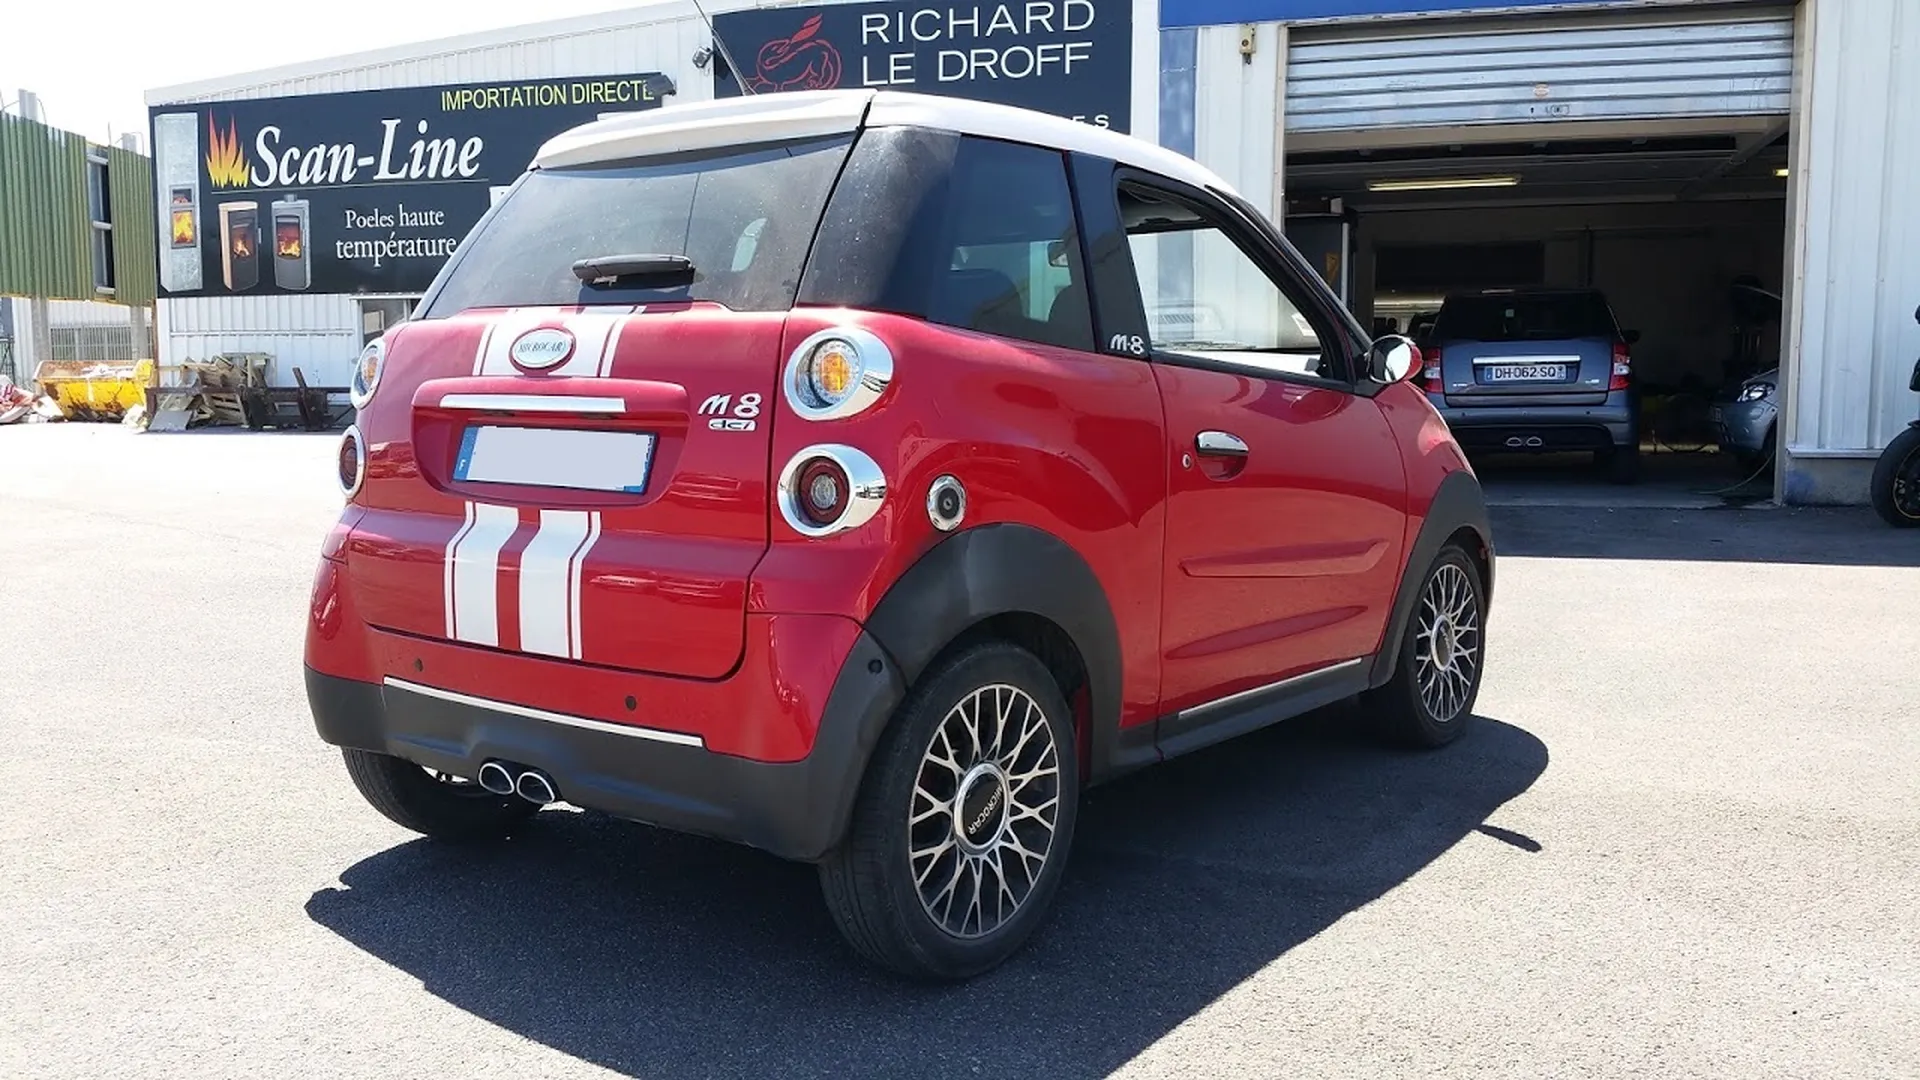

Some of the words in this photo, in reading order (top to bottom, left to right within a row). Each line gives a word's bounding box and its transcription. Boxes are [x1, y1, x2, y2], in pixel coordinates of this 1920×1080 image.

[861, 0, 1096, 46] RICHARD
[862, 53, 916, 87] LE
[938, 41, 1094, 82] DROFF
[441, 85, 567, 112] IMPORTATION
[251, 118, 484, 188] Scan-Line
[345, 208, 394, 229] Poeles
[398, 203, 445, 226] haute
[335, 231, 457, 268] température
[967, 784, 1003, 835] MICROCAR
